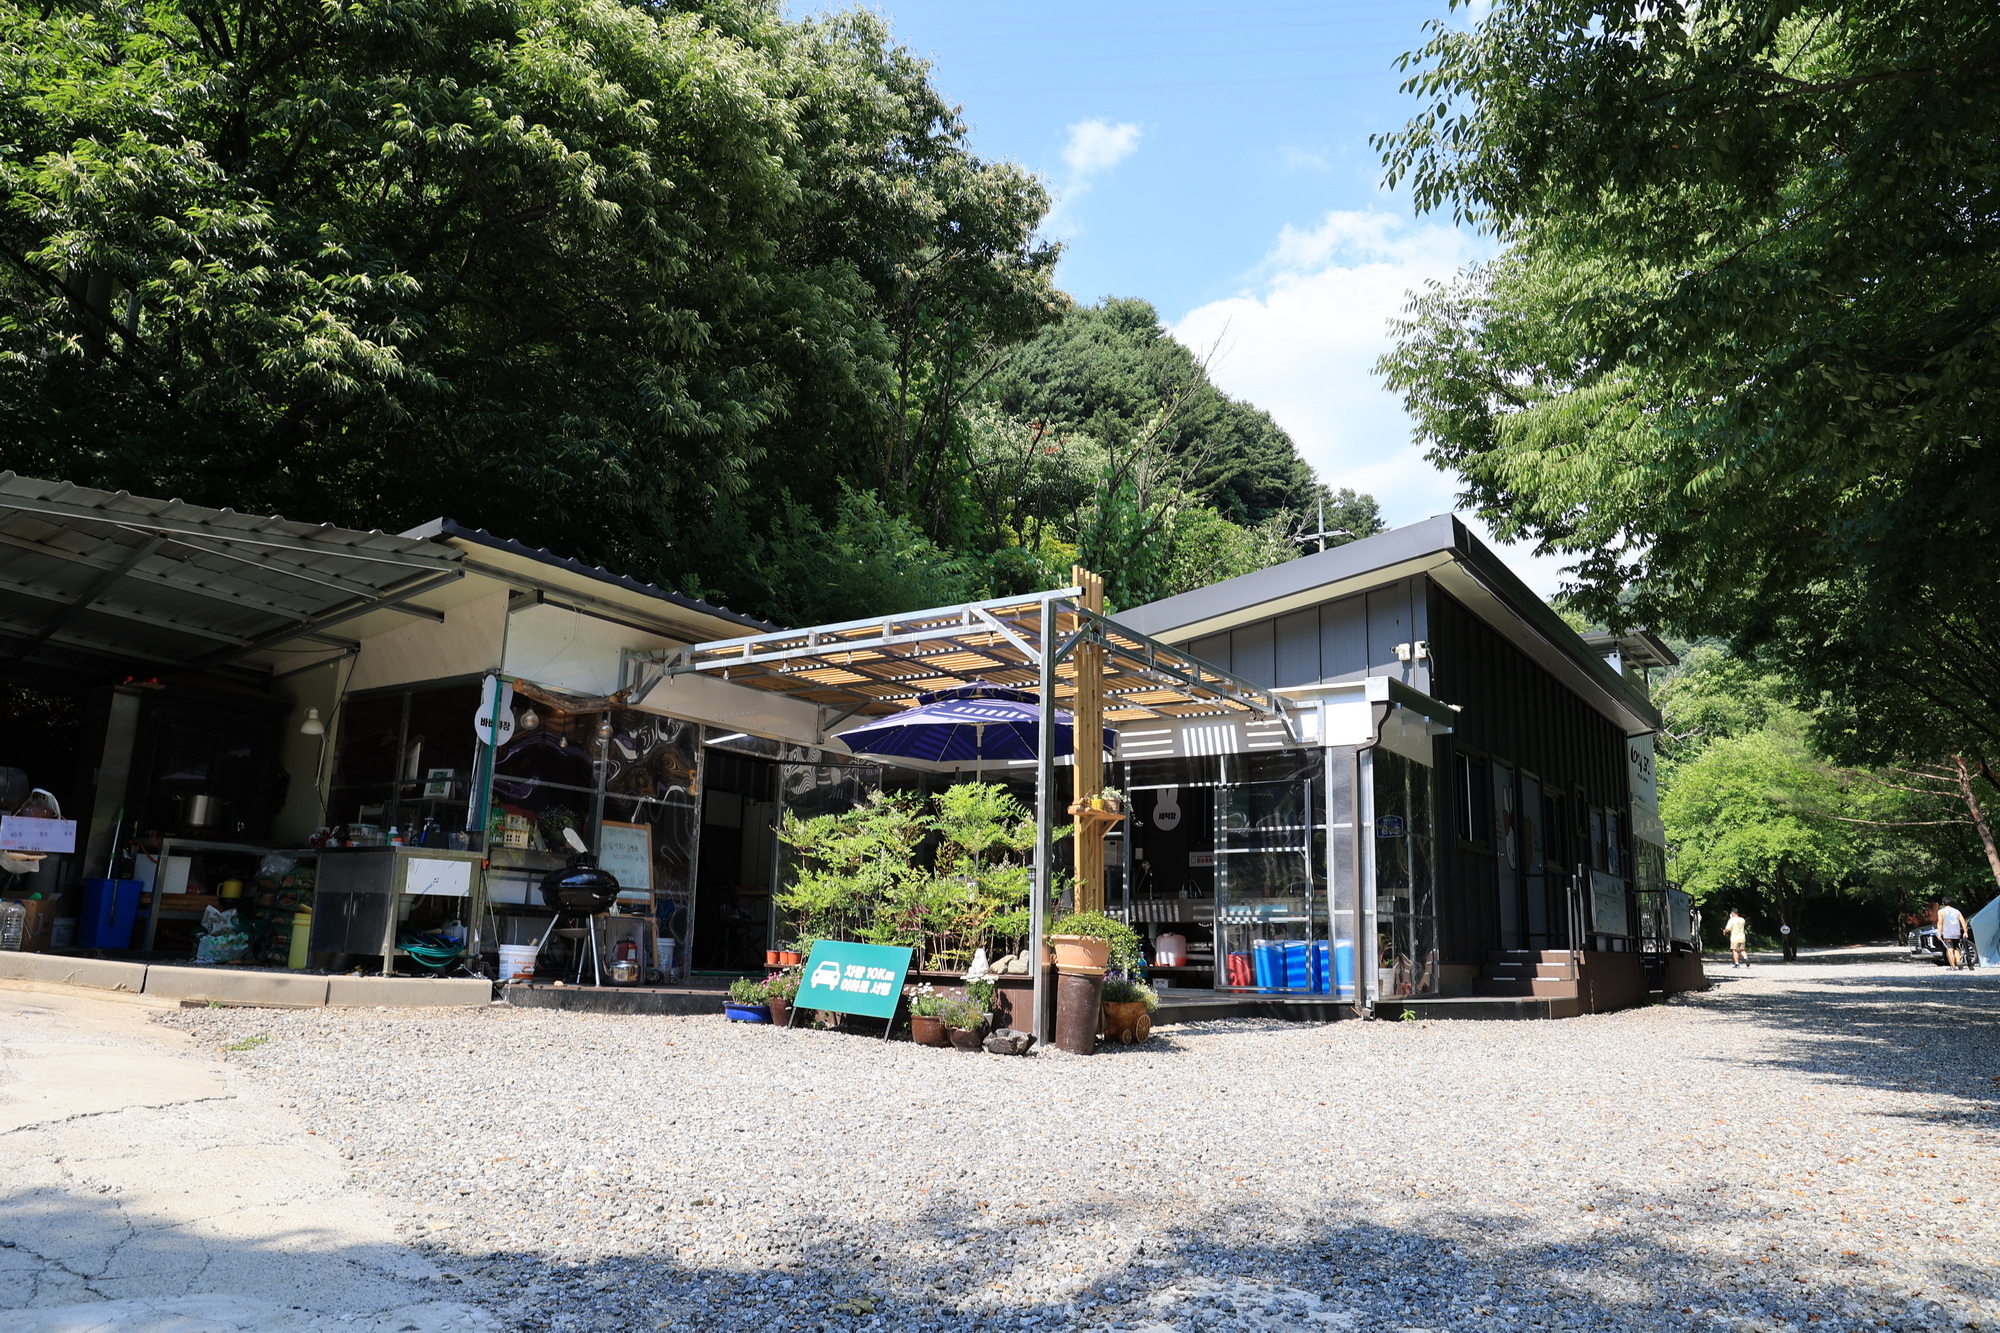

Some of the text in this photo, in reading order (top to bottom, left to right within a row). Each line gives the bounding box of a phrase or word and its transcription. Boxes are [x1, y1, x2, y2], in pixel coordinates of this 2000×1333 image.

[844, 964, 895, 982] 차량 10Km
[840, 978, 892, 996] 이하로 서행
